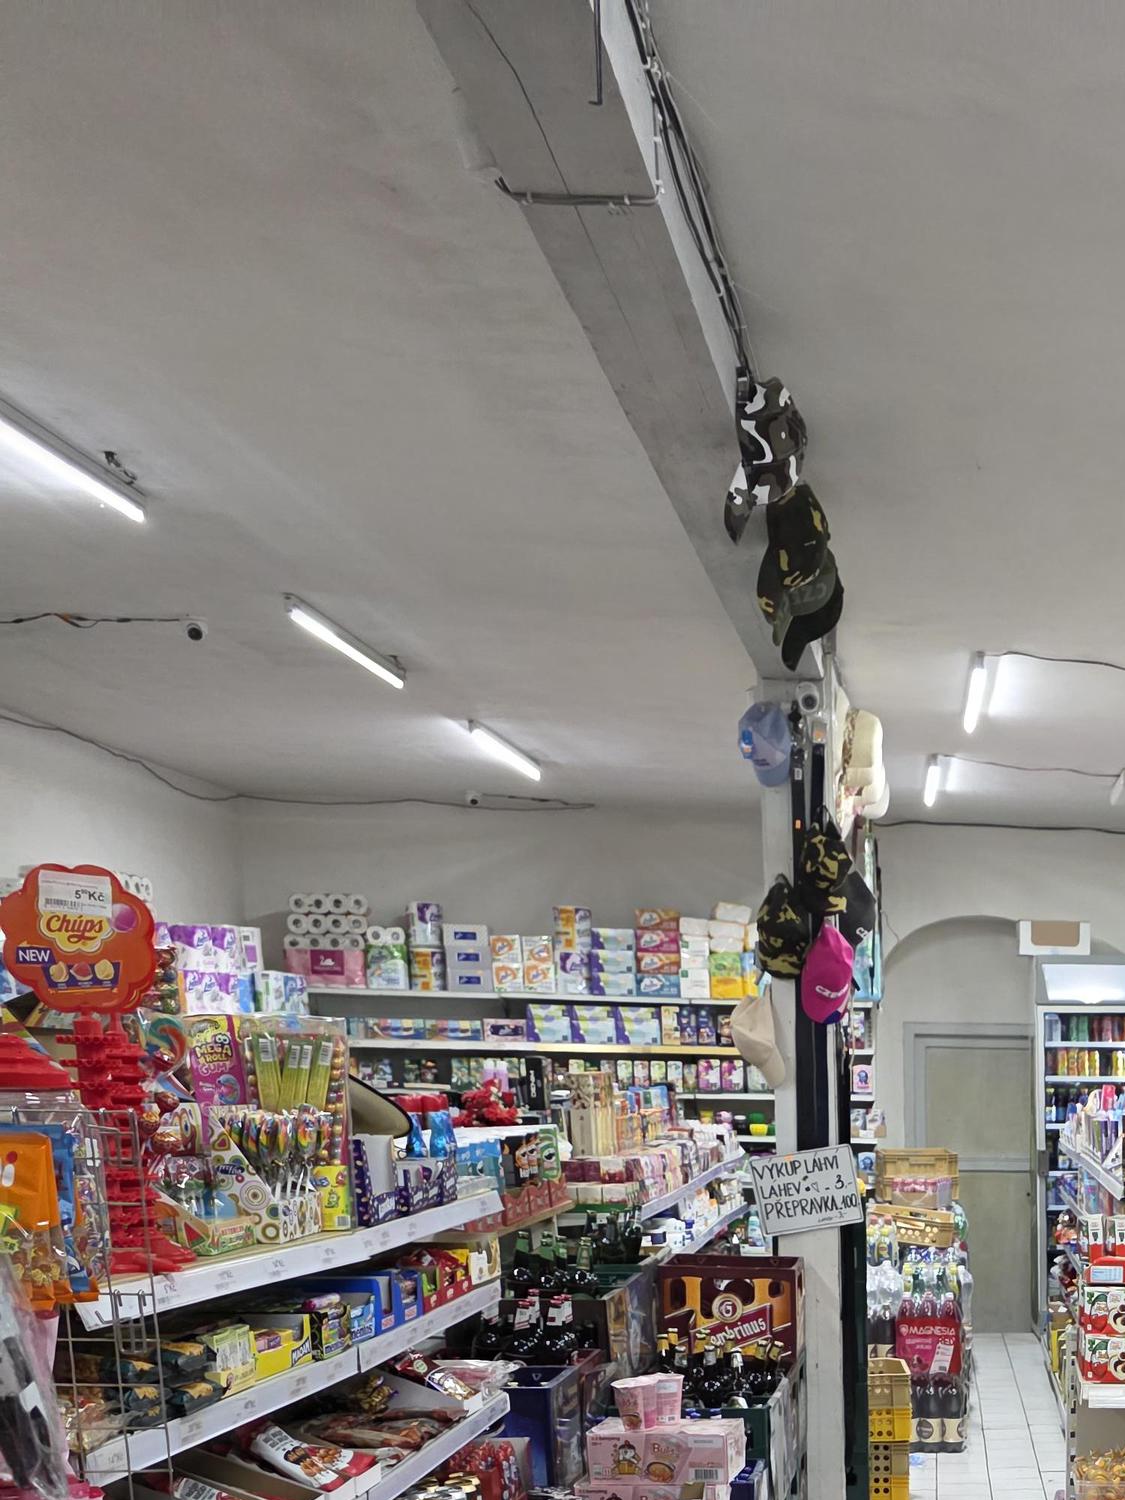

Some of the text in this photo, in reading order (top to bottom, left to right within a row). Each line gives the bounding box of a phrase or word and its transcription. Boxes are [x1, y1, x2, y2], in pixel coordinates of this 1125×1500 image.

[18, 949, 51, 962] NEW
[200, 1063, 231, 1076] GUM
[909, 1325, 955, 1336] MAGNESIA
